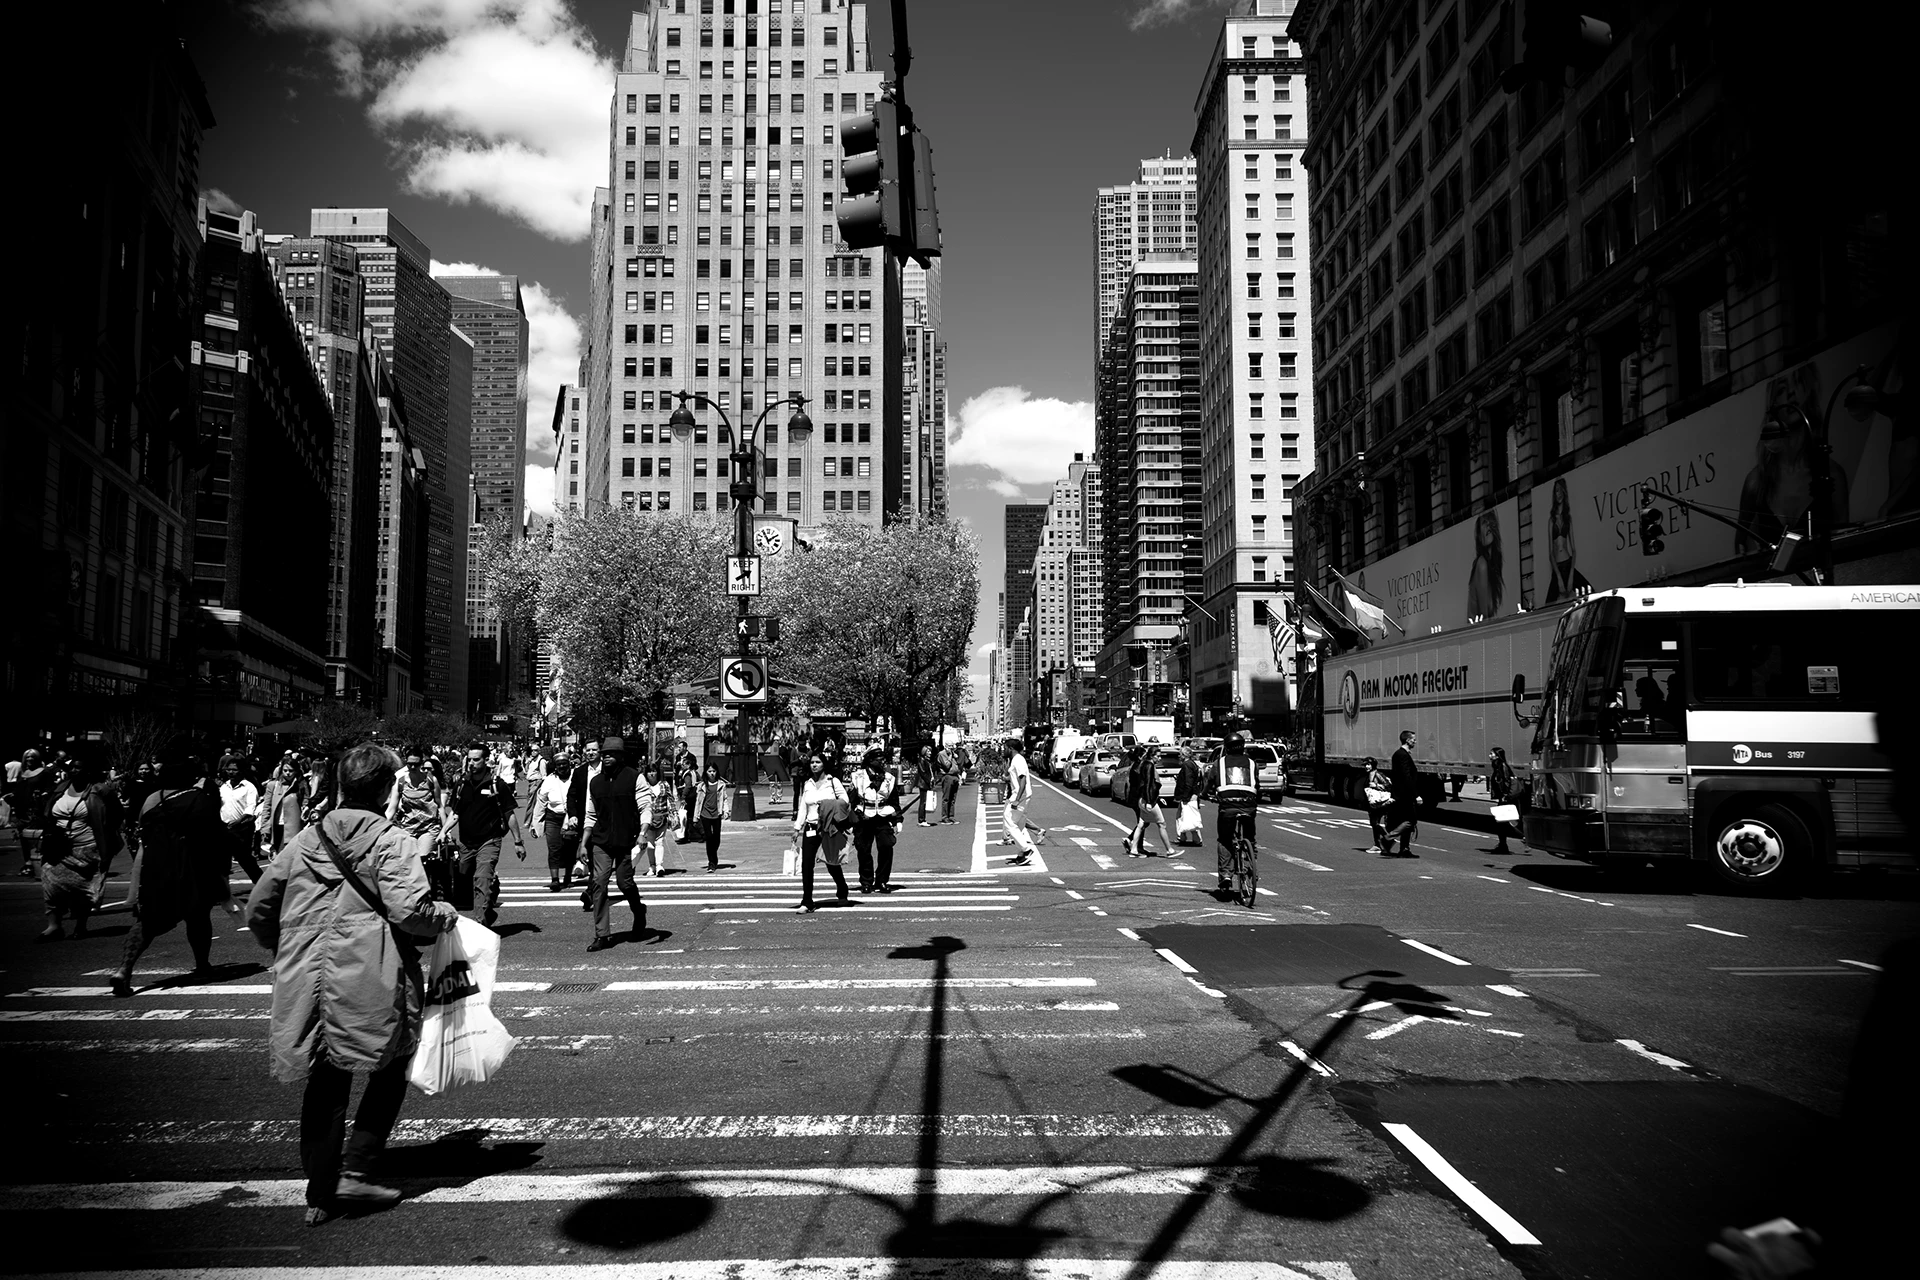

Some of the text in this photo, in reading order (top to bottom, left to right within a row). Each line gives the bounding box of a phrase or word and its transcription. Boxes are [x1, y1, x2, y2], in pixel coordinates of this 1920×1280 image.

[1593, 452, 1716, 522] VICTORIA'S
[732, 560, 754, 568] KEEP
[731, 583, 756, 591] RIGHT
[1387, 562, 1440, 598] VICTORIA'S
[1397, 590, 1431, 619] SECRET
[1384, 672, 1418, 698] MOTOR
[1422, 665, 1468, 694] FREIGHT
[1754, 750, 1773, 759] Bus
[1787, 750, 1806, 759] 3197
